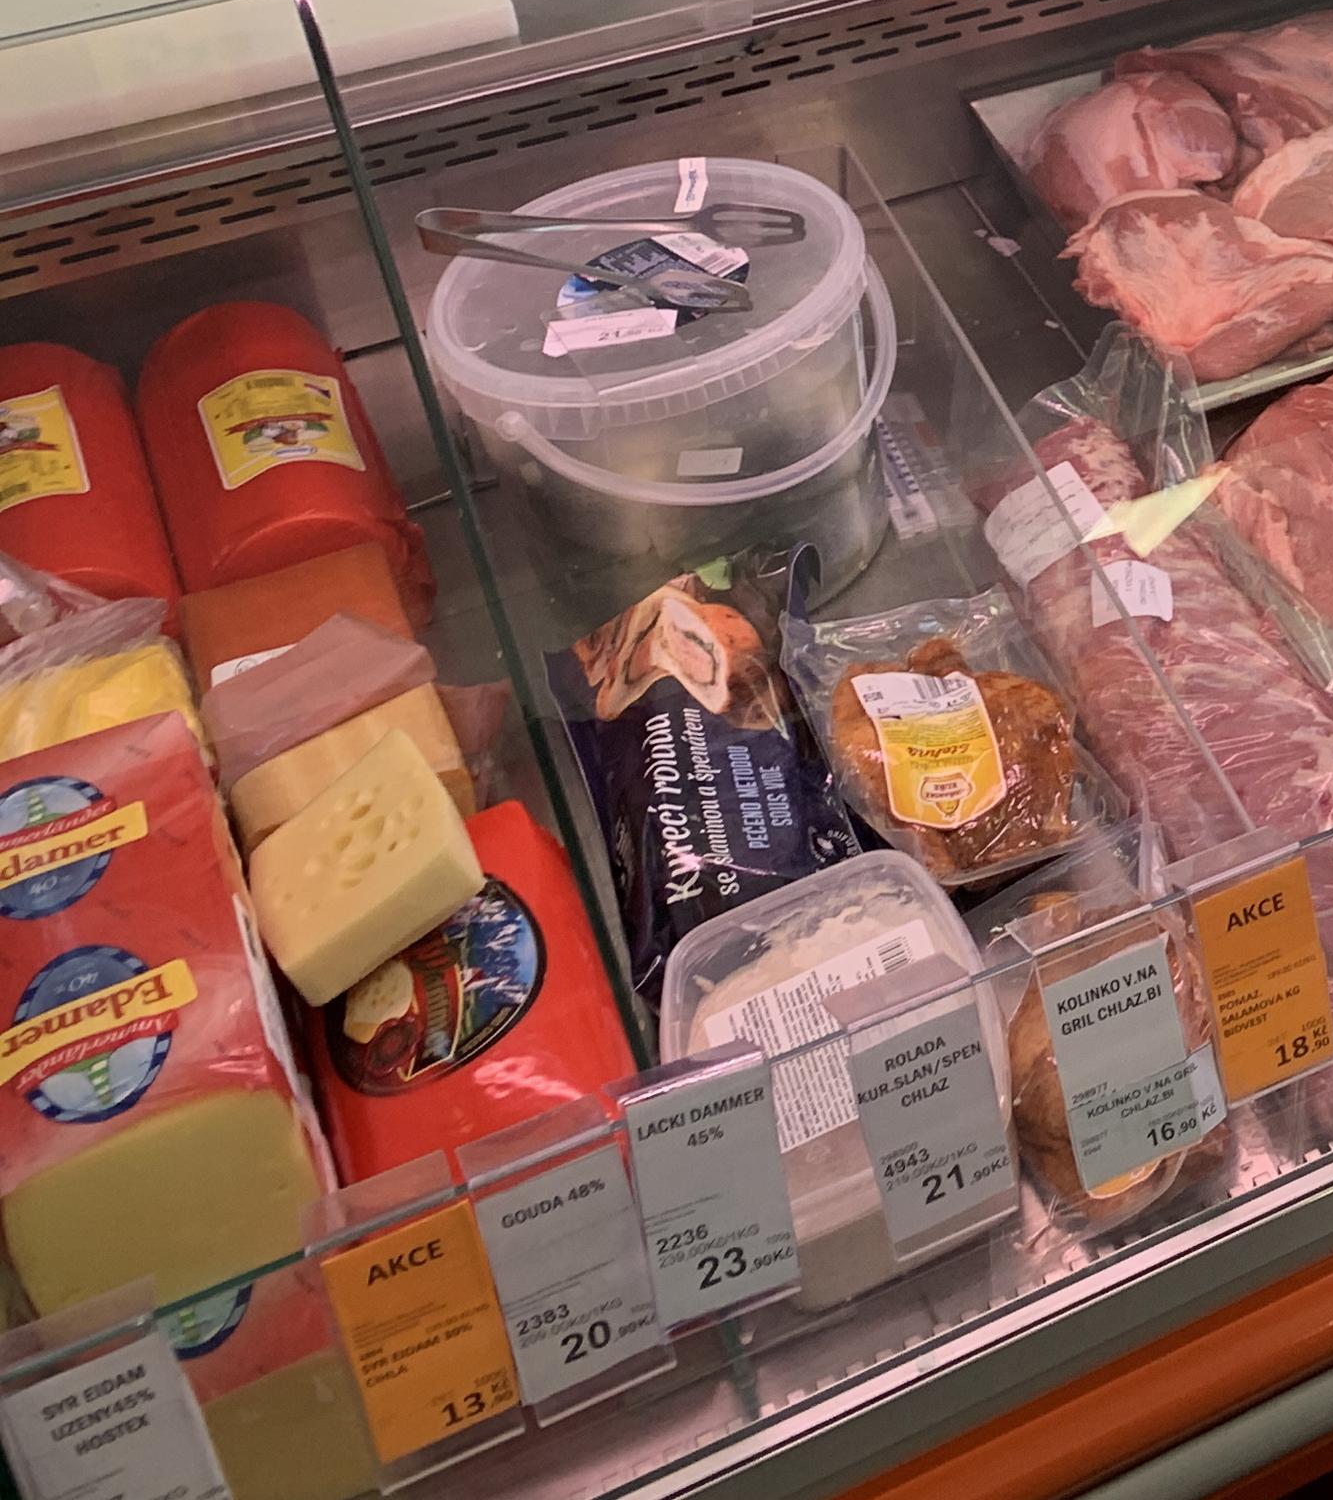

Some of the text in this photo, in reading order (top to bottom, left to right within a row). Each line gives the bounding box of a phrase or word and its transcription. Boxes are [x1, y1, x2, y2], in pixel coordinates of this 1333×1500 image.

[759, 764, 793, 827] SOUS VIDE
[0, 823, 126, 881] damer
[716, 870, 740, 897] se
[1226, 892, 1286, 933] AKCE
[2, 972, 174, 1058] Edamer
[1056, 978, 1121, 1016] KOLINKO
[1061, 1013, 1095, 1037] GRIL
[884, 1035, 946, 1073] ROLADA
[1275, 1036, 1310, 1067] 18
[690, 1086, 765, 1123] DAMMER
[901, 1077, 949, 1108] CHLAZ
[687, 1123, 725, 1148] 45%
[883, 1147, 930, 1180] 4943
[501, 1194, 564, 1230] GOUDA
[656, 1223, 710, 1256] 2236
[366, 1238, 445, 1287] AKCE
[516, 1303, 571, 1337] 2383
[41, 1394, 80, 1422] SYR
[440, 1390, 486, 1428] 13
